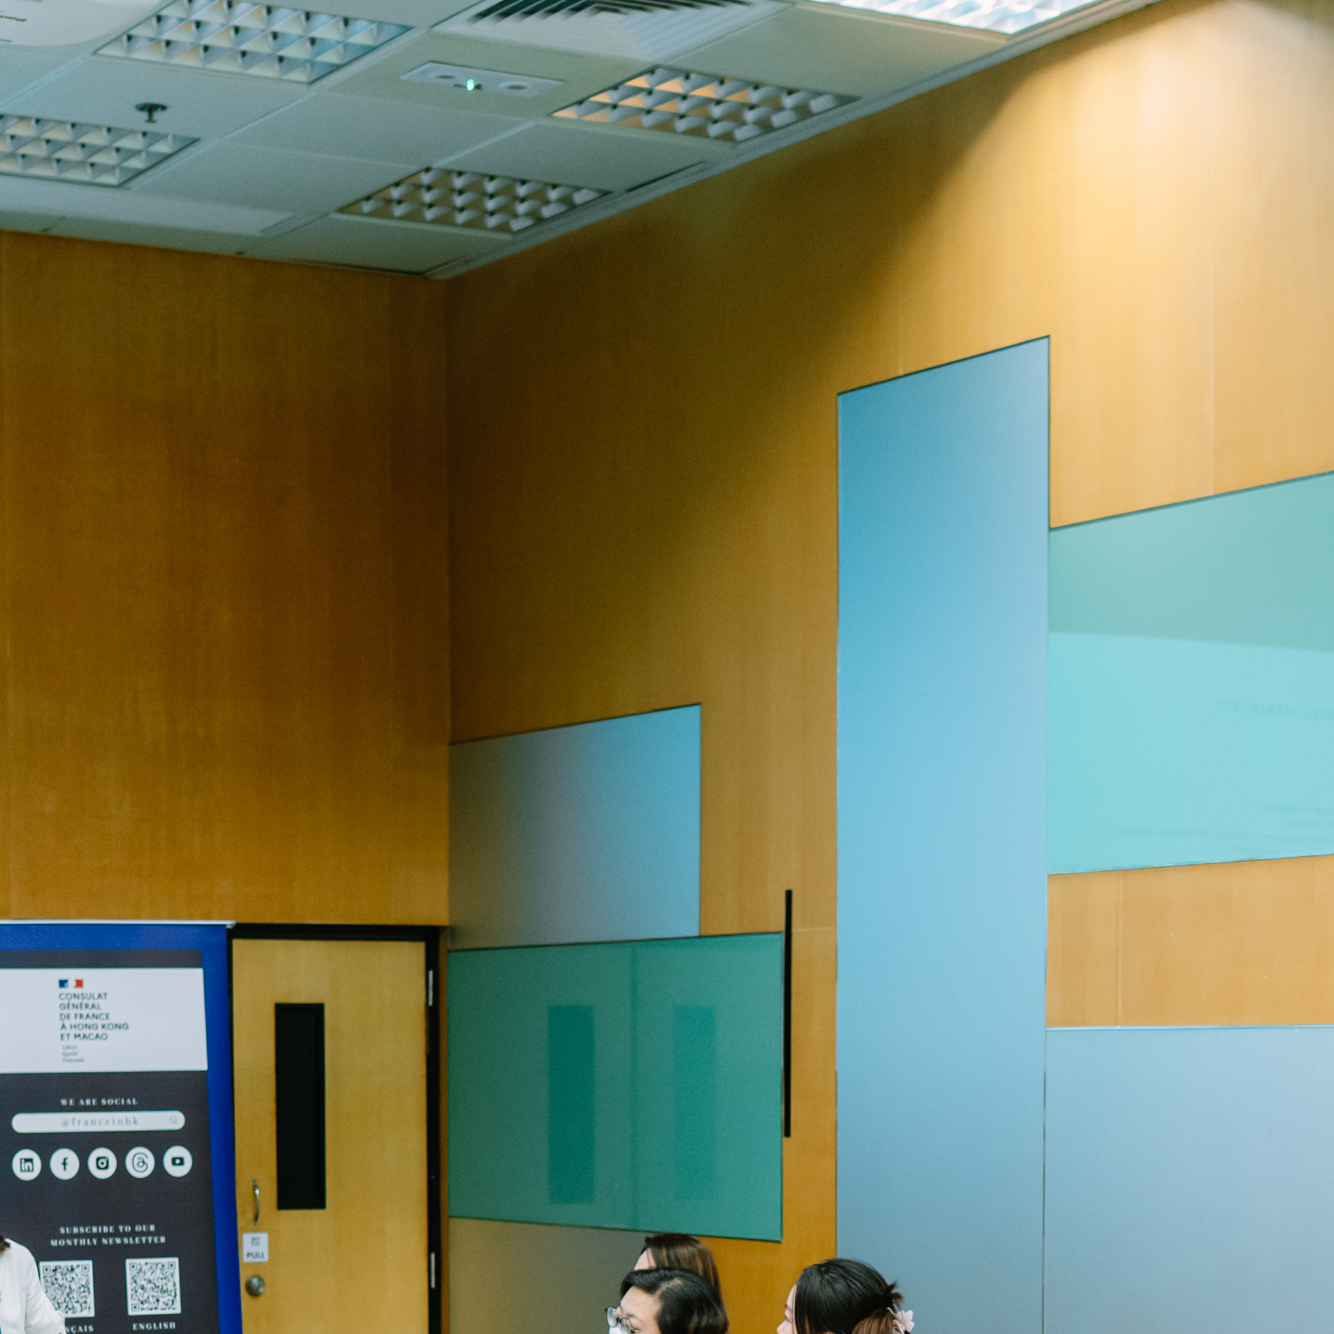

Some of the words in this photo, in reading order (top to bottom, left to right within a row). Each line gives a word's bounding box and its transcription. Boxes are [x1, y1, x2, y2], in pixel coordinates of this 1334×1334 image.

[58, 992, 108, 1001] CONSULAT
[59, 1001, 102, 1011] GÉNÉRAL
[60, 1012, 71, 1021] DE
[74, 1012, 110, 1021] FRANCE
[61, 1021, 67, 1031] À
[69, 1023, 99, 1031] HONG
[101, 1022, 129, 1031] KONG
[60, 1033, 71, 1041] ET
[74, 1033, 109, 1041] MACAO
[60, 1098, 75, 1106] WE
[79, 1098, 98, 1106] ARE
[101, 1097, 138, 1106] SOCIAL
[59, 1225, 115, 1235] SUBSCRIBE
[118, 1224, 132, 1233] TO
[135, 1224, 156, 1232] OUR
[50, 1238, 98, 1247] MONTHLY
[101, 1236, 166, 1246] NEWSLETTER
[132, 1321, 176, 1331] ENGLISH
